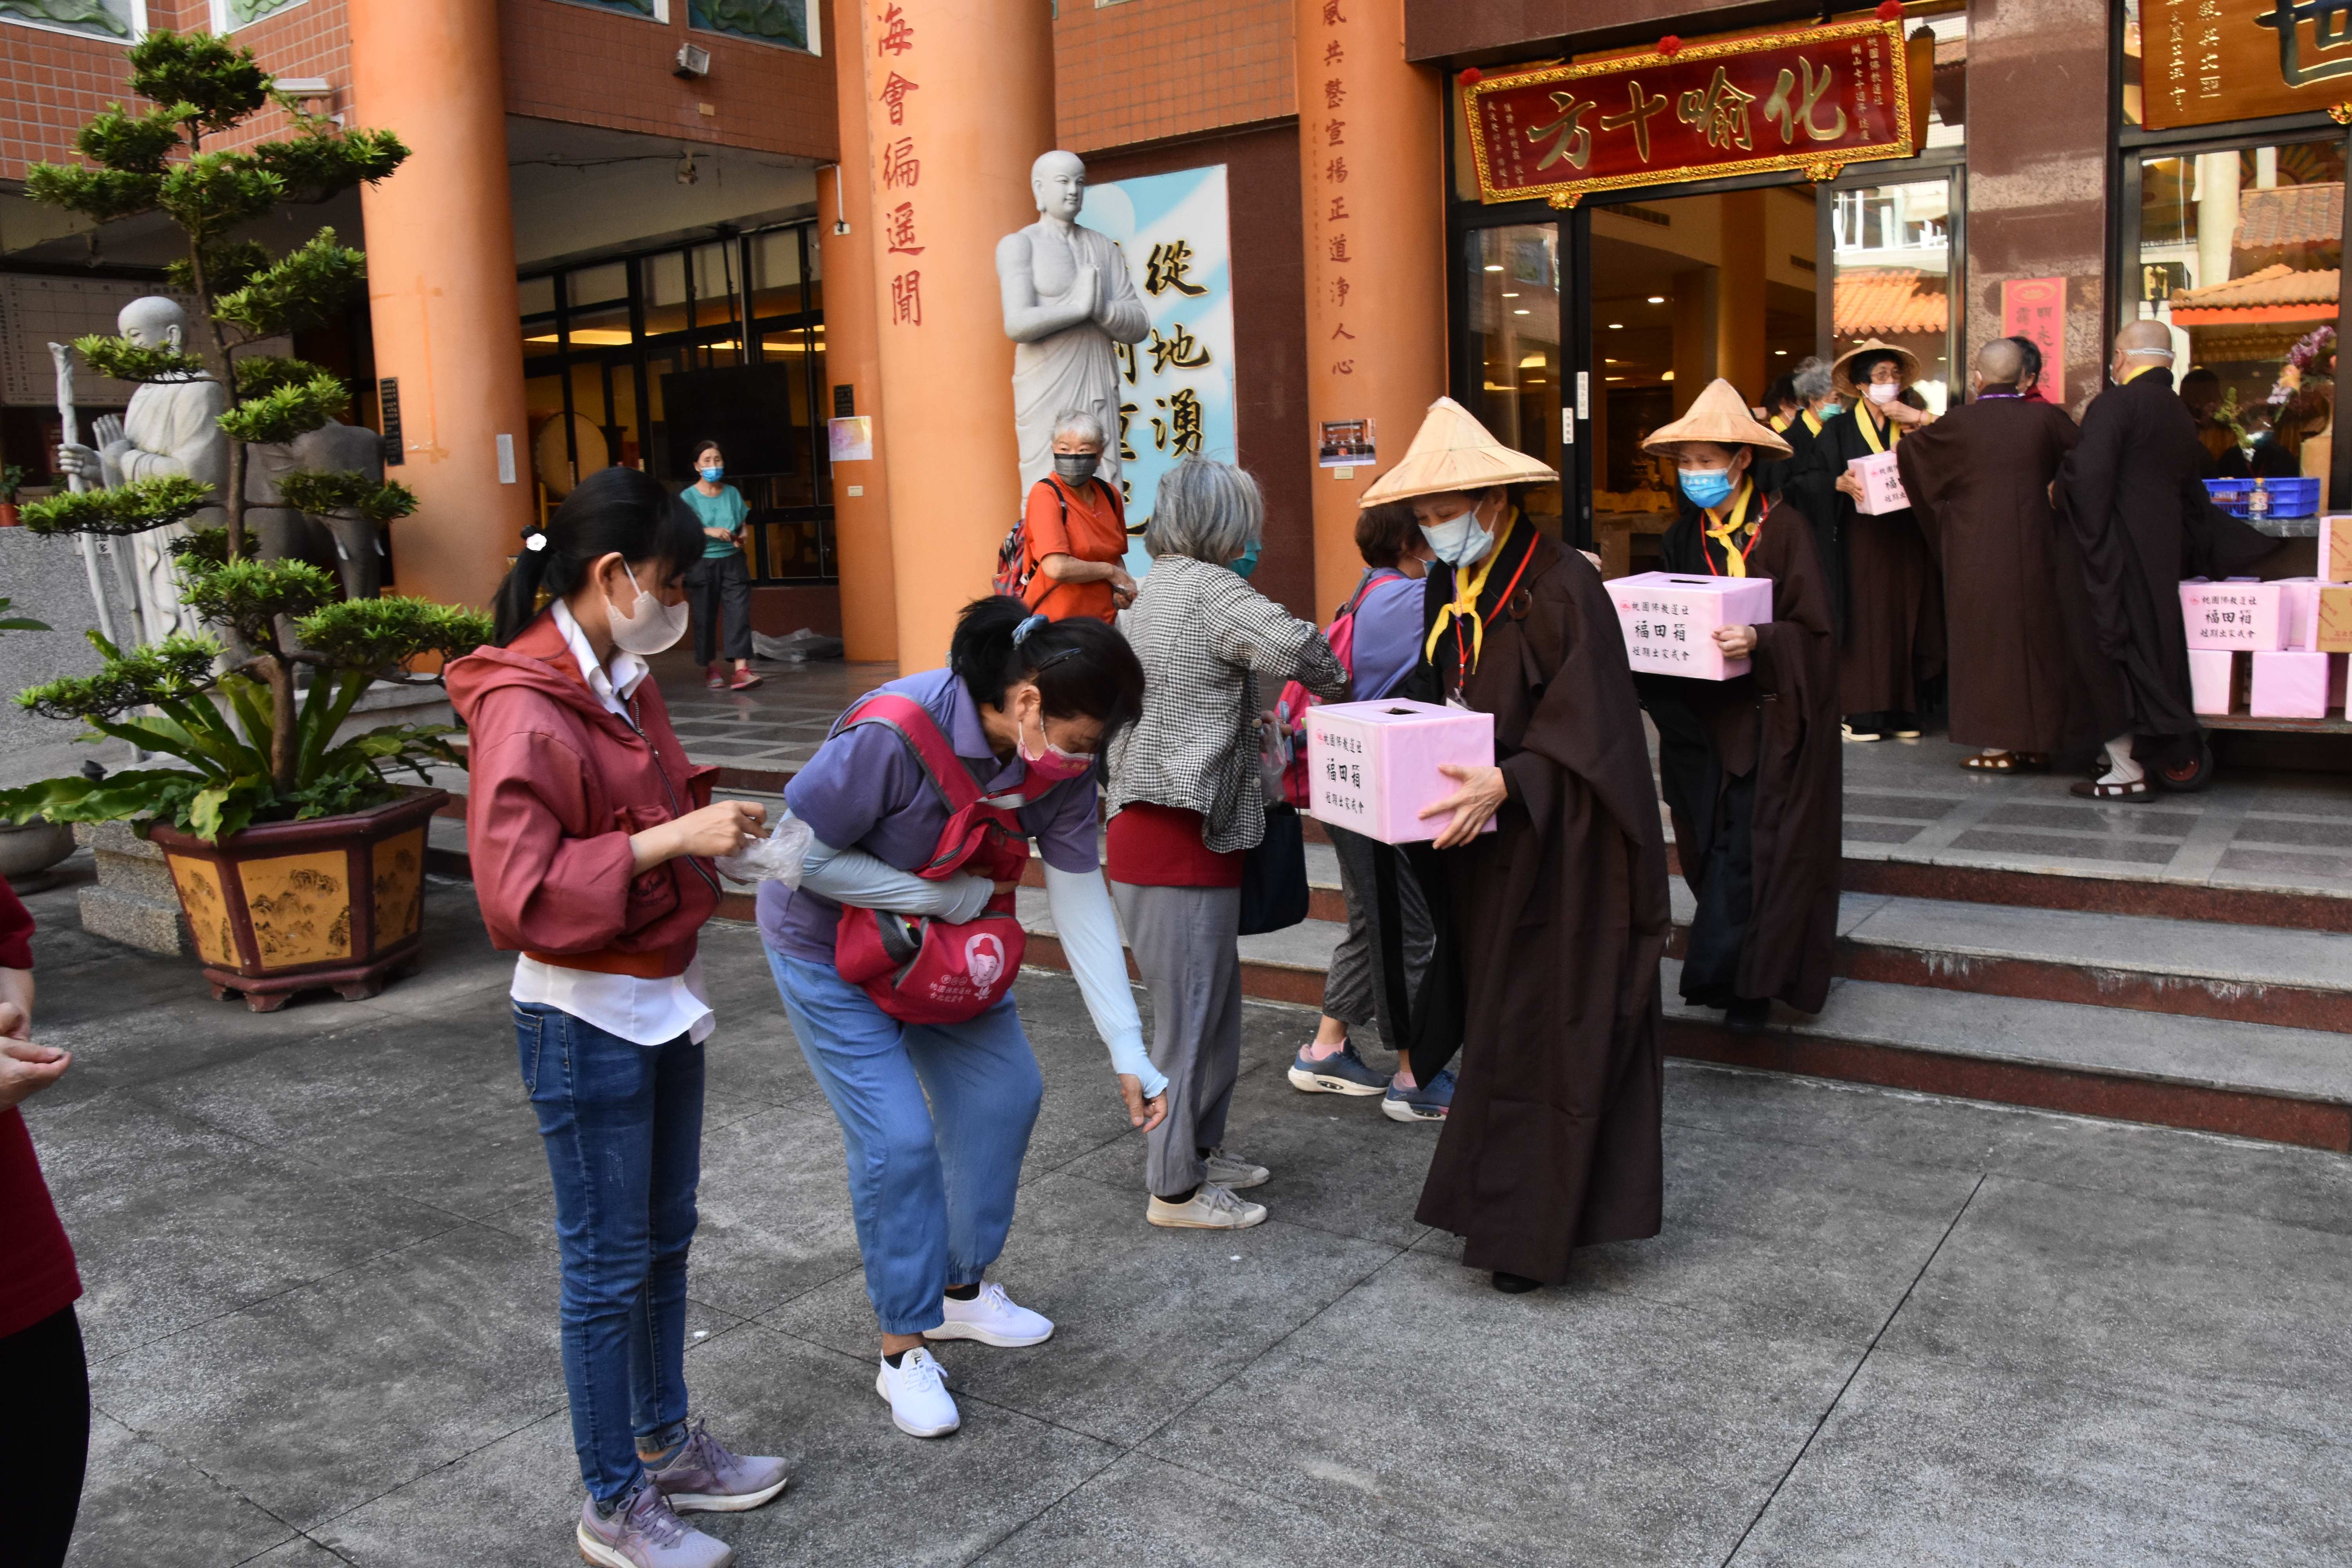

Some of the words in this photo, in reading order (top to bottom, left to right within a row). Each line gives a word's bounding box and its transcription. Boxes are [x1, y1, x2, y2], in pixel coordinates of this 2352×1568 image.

[1632, 601, 1690, 615] 桃園佛教蓮社
[2201, 595, 2258, 606] 桃園佛教蓮社
[2205, 609, 2252, 624] 福田箱
[1635, 620, 1686, 642] 福田箱
[2200, 629, 2256, 639] 短期出家戒會
[1632, 646, 1690, 661] 短期出家戒會
[1323, 733, 1363, 754] 桃園佛教蓮社
[1327, 758, 1361, 789] 福田箱
[1325, 791, 1364, 814] 短期出家戒會
